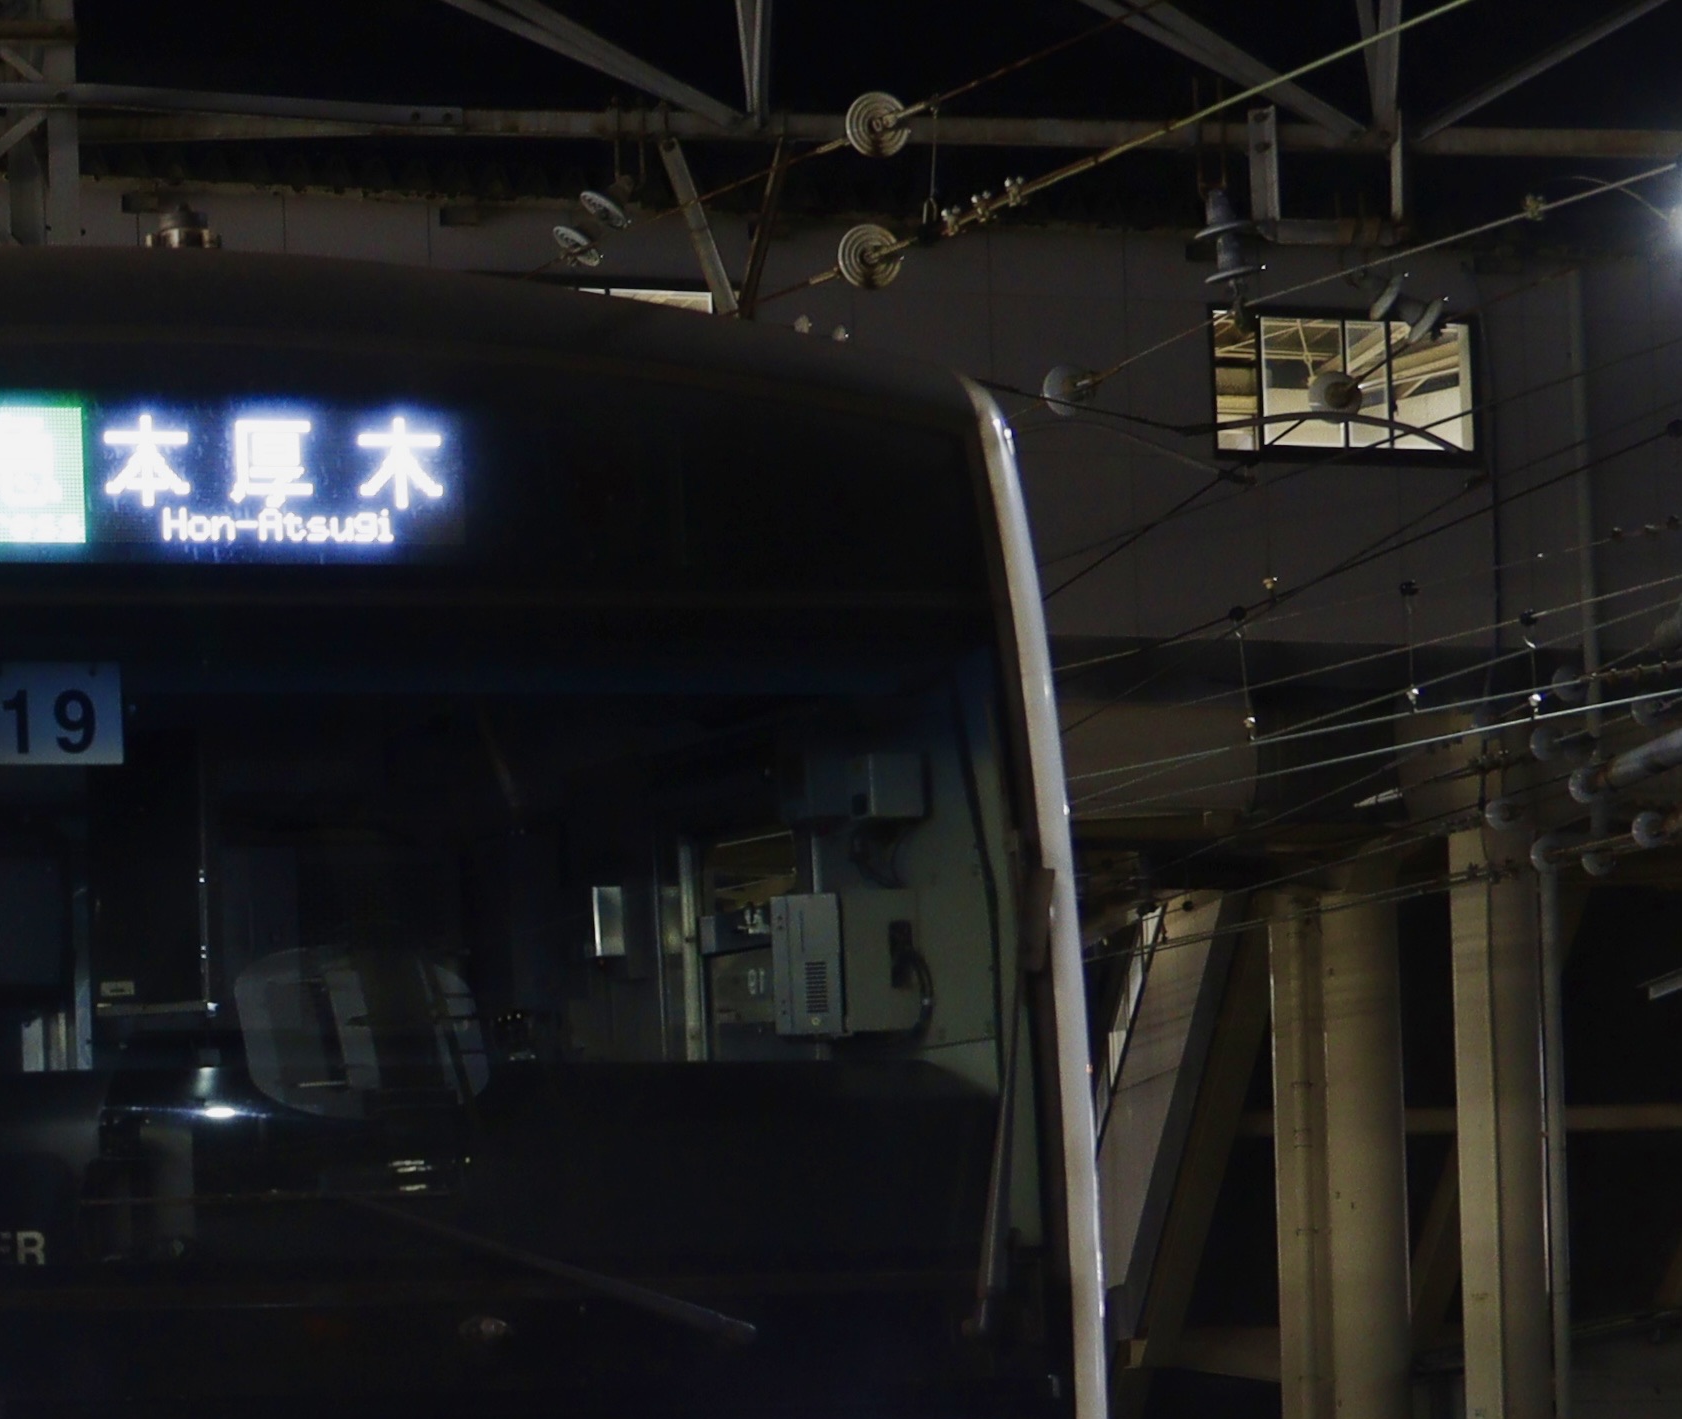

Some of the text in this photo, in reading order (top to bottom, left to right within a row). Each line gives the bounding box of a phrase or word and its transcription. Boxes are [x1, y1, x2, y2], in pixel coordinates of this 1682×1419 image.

[103, 414, 444, 509] 本厚木
[162, 506, 396, 544] Hon-Atsugi
[2, 688, 97, 755] 19
